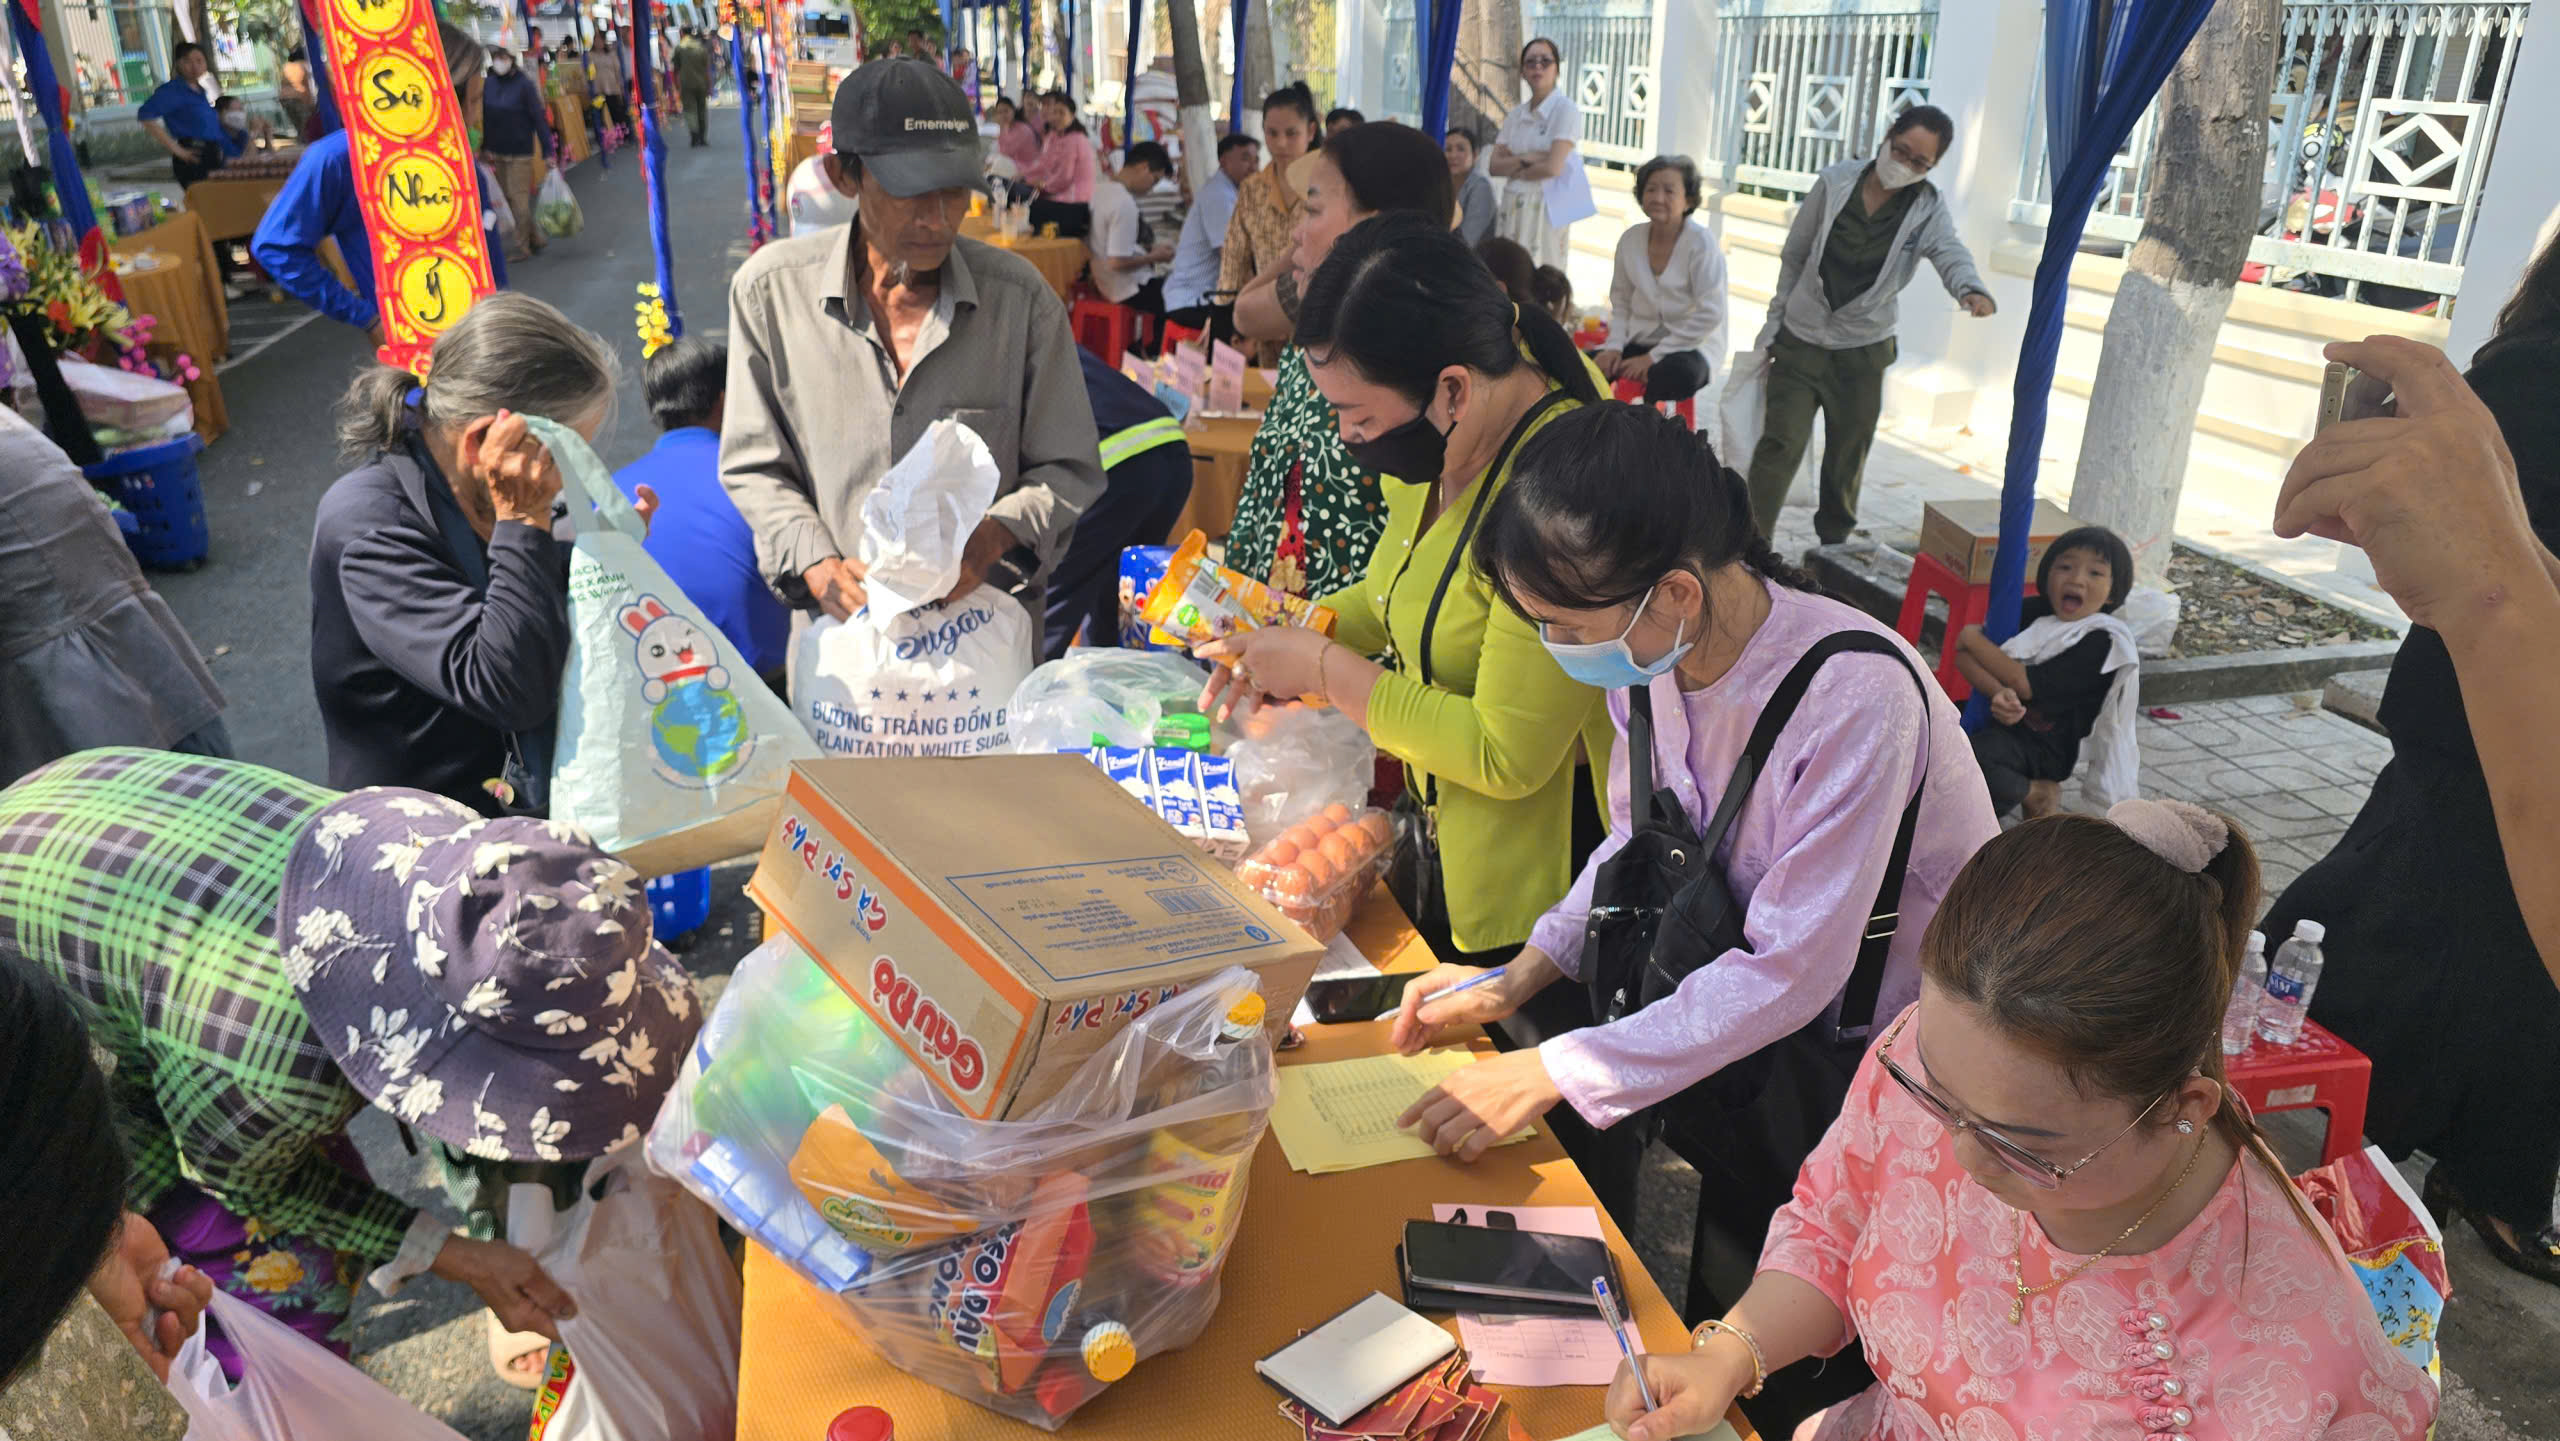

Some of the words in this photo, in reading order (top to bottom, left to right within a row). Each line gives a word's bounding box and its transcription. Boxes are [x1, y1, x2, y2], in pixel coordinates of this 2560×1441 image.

[388, 170, 453, 209] Như
[896, 603, 995, 660] Sugar
[816, 729, 914, 757] PLANTATION
[920, 738, 971, 757] WHITE
[782, 814, 820, 872] Phở
[821, 853, 856, 900] Sợi
[858, 887, 887, 931] Gà
[1054, 998, 1105, 1035] Phở
